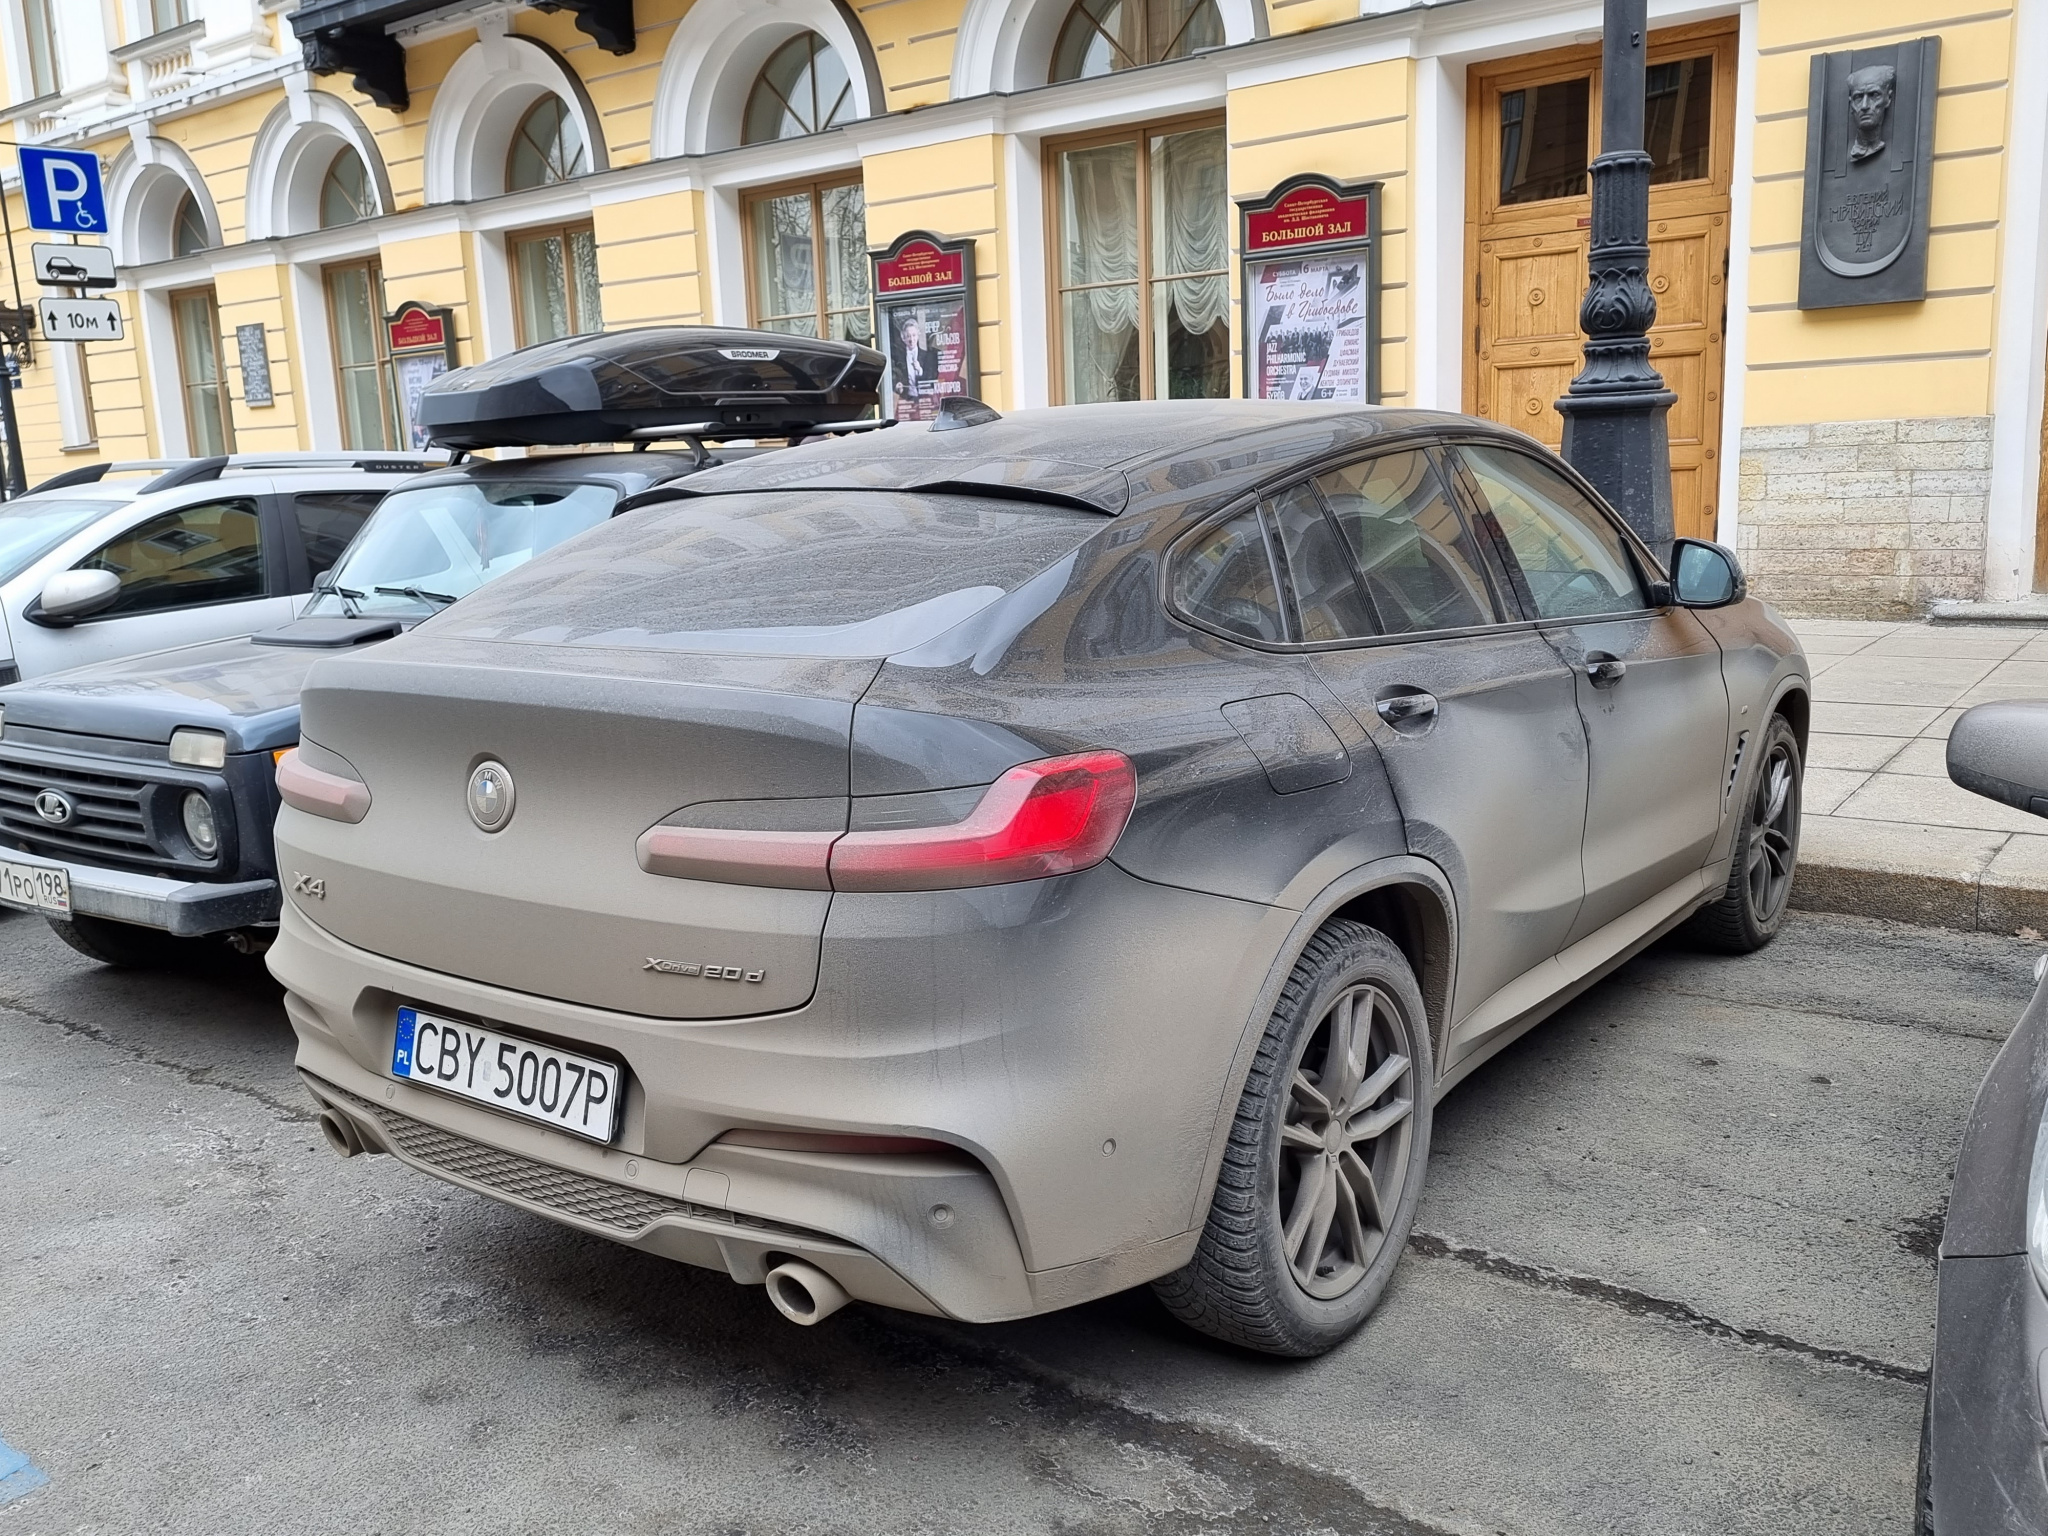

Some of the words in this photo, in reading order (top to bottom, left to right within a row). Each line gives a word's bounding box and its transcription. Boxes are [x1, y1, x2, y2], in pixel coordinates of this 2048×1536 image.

[42, 158, 88, 223] P
[1261, 223, 1324, 243] БОЛЬШОЙ
[1327, 221, 1352, 235] ЗАЛ
[888, 271, 933, 287] БОЛЬШОЙ
[934, 270, 952, 282] ЗАЛ
[1265, 283, 1295, 302] Было
[1298, 282, 1325, 299] дело
[730, 350, 769, 359] BROOMER
[1320, 388, 1333, 398] 6+
[36, 871, 64, 897] 198
[292, 870, 326, 901] X4
[43, 894, 58, 905] RUS
[397, 1050, 410, 1066] PL
[415, 1022, 486, 1089] CBY
[493, 1042, 608, 1126] 5007P
